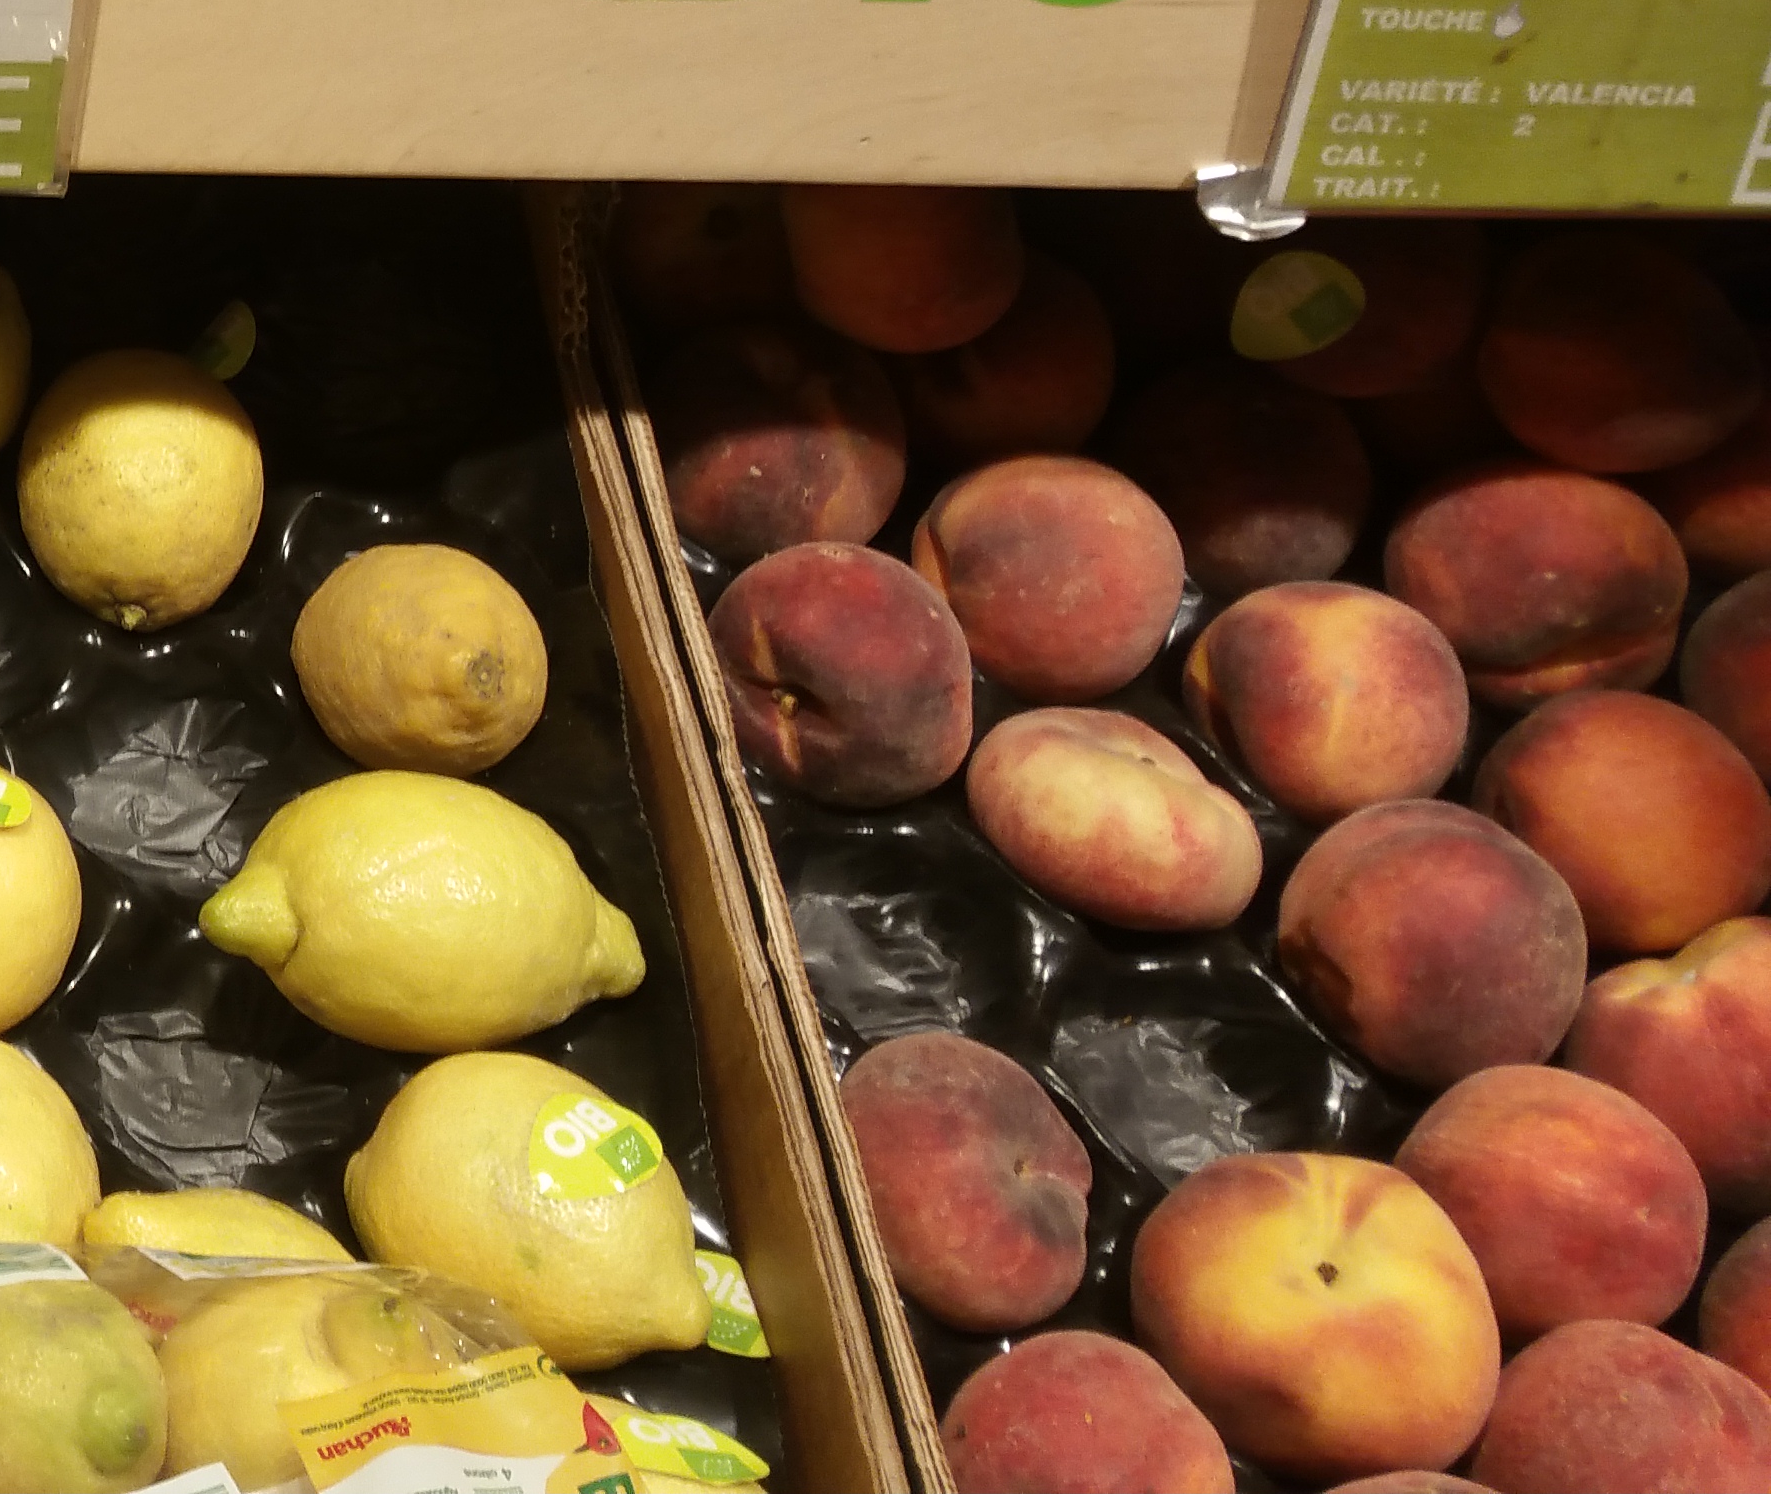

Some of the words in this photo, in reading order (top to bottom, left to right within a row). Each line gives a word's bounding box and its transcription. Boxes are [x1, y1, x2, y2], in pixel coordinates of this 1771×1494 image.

[1361, 6, 1488, 32] TOUCHE
[1339, 76, 1484, 104] VARIÉTÉ
[1525, 81, 1697, 107] VALENCIA
[1329, 112, 1407, 136] CAT.
[1512, 113, 1537, 138] 2
[1313, 176, 1419, 200] TRAIT.
[543, 1100, 619, 1158] BIO
[316, 1416, 412, 1460] Auchan
[626, 1415, 719, 1450] BIO
